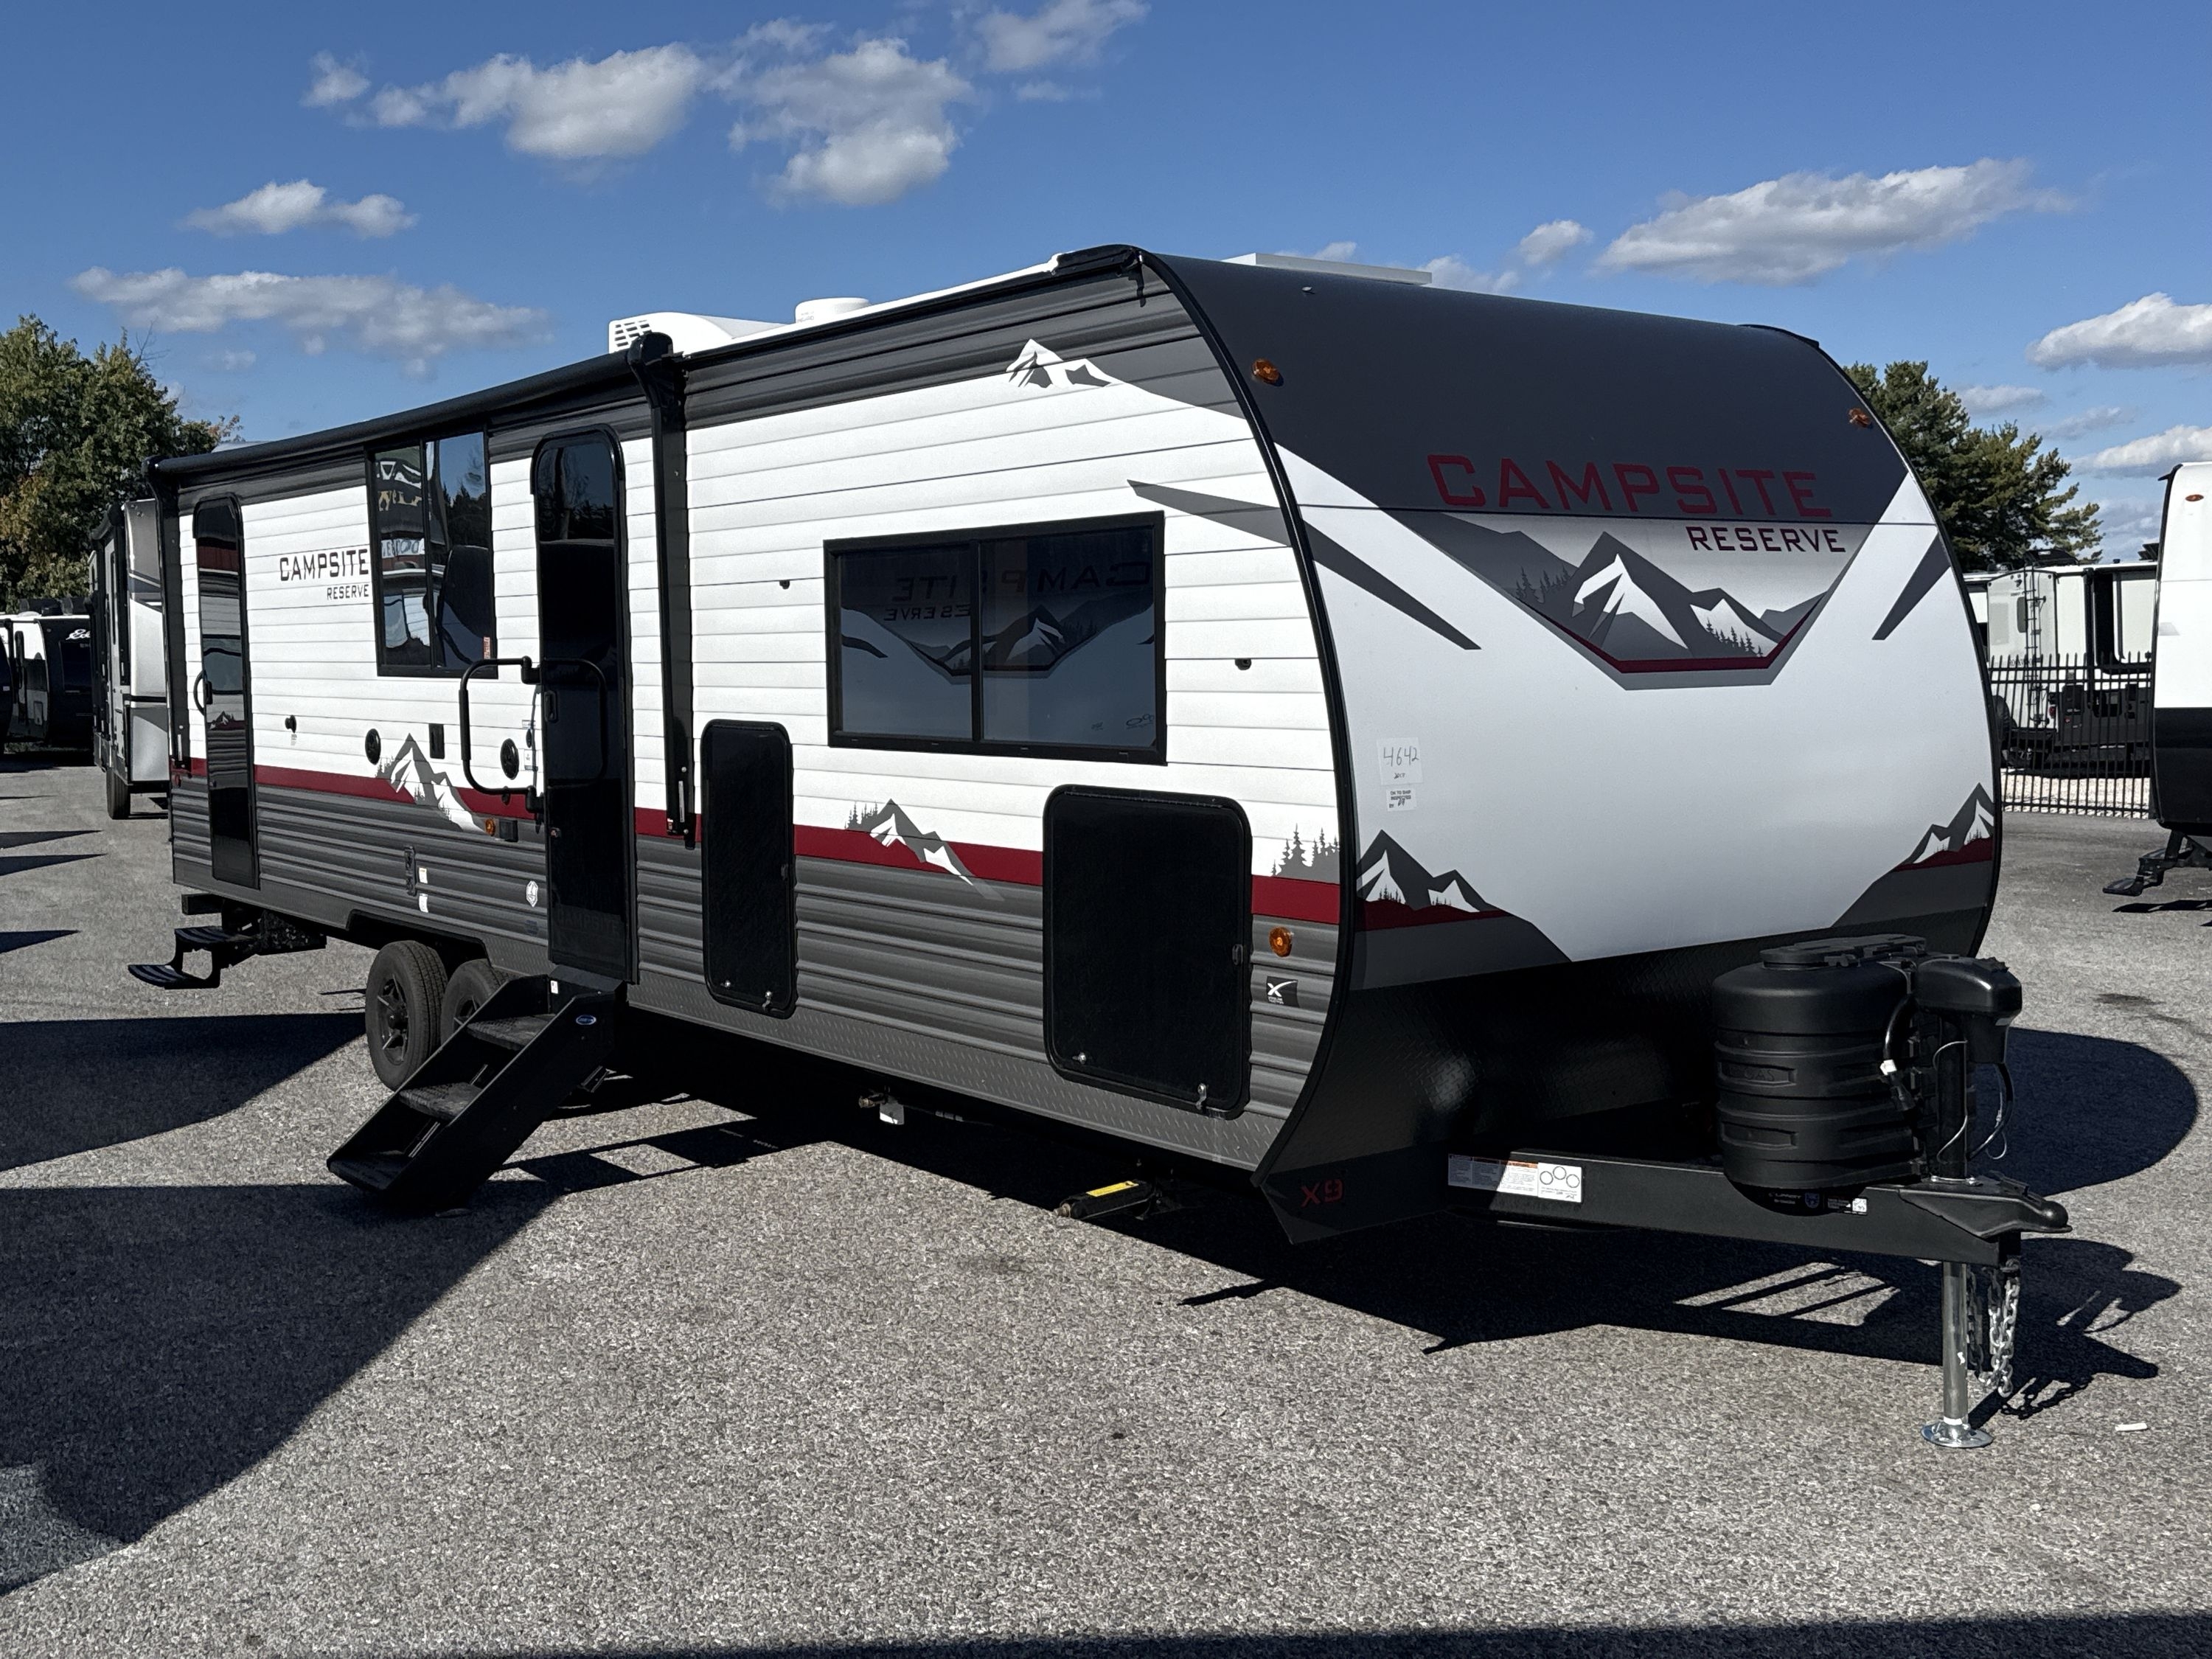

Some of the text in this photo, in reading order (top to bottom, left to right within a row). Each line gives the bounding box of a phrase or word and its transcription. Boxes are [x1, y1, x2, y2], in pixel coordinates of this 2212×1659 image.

[1427, 454, 1832, 517] CAMPSITE
[1686, 526, 1846, 552] RESERVE
[280, 549, 369, 581] CAMPSITE
[327, 584, 369, 600] RESERVE
[1383, 746, 1419, 767] 4642
